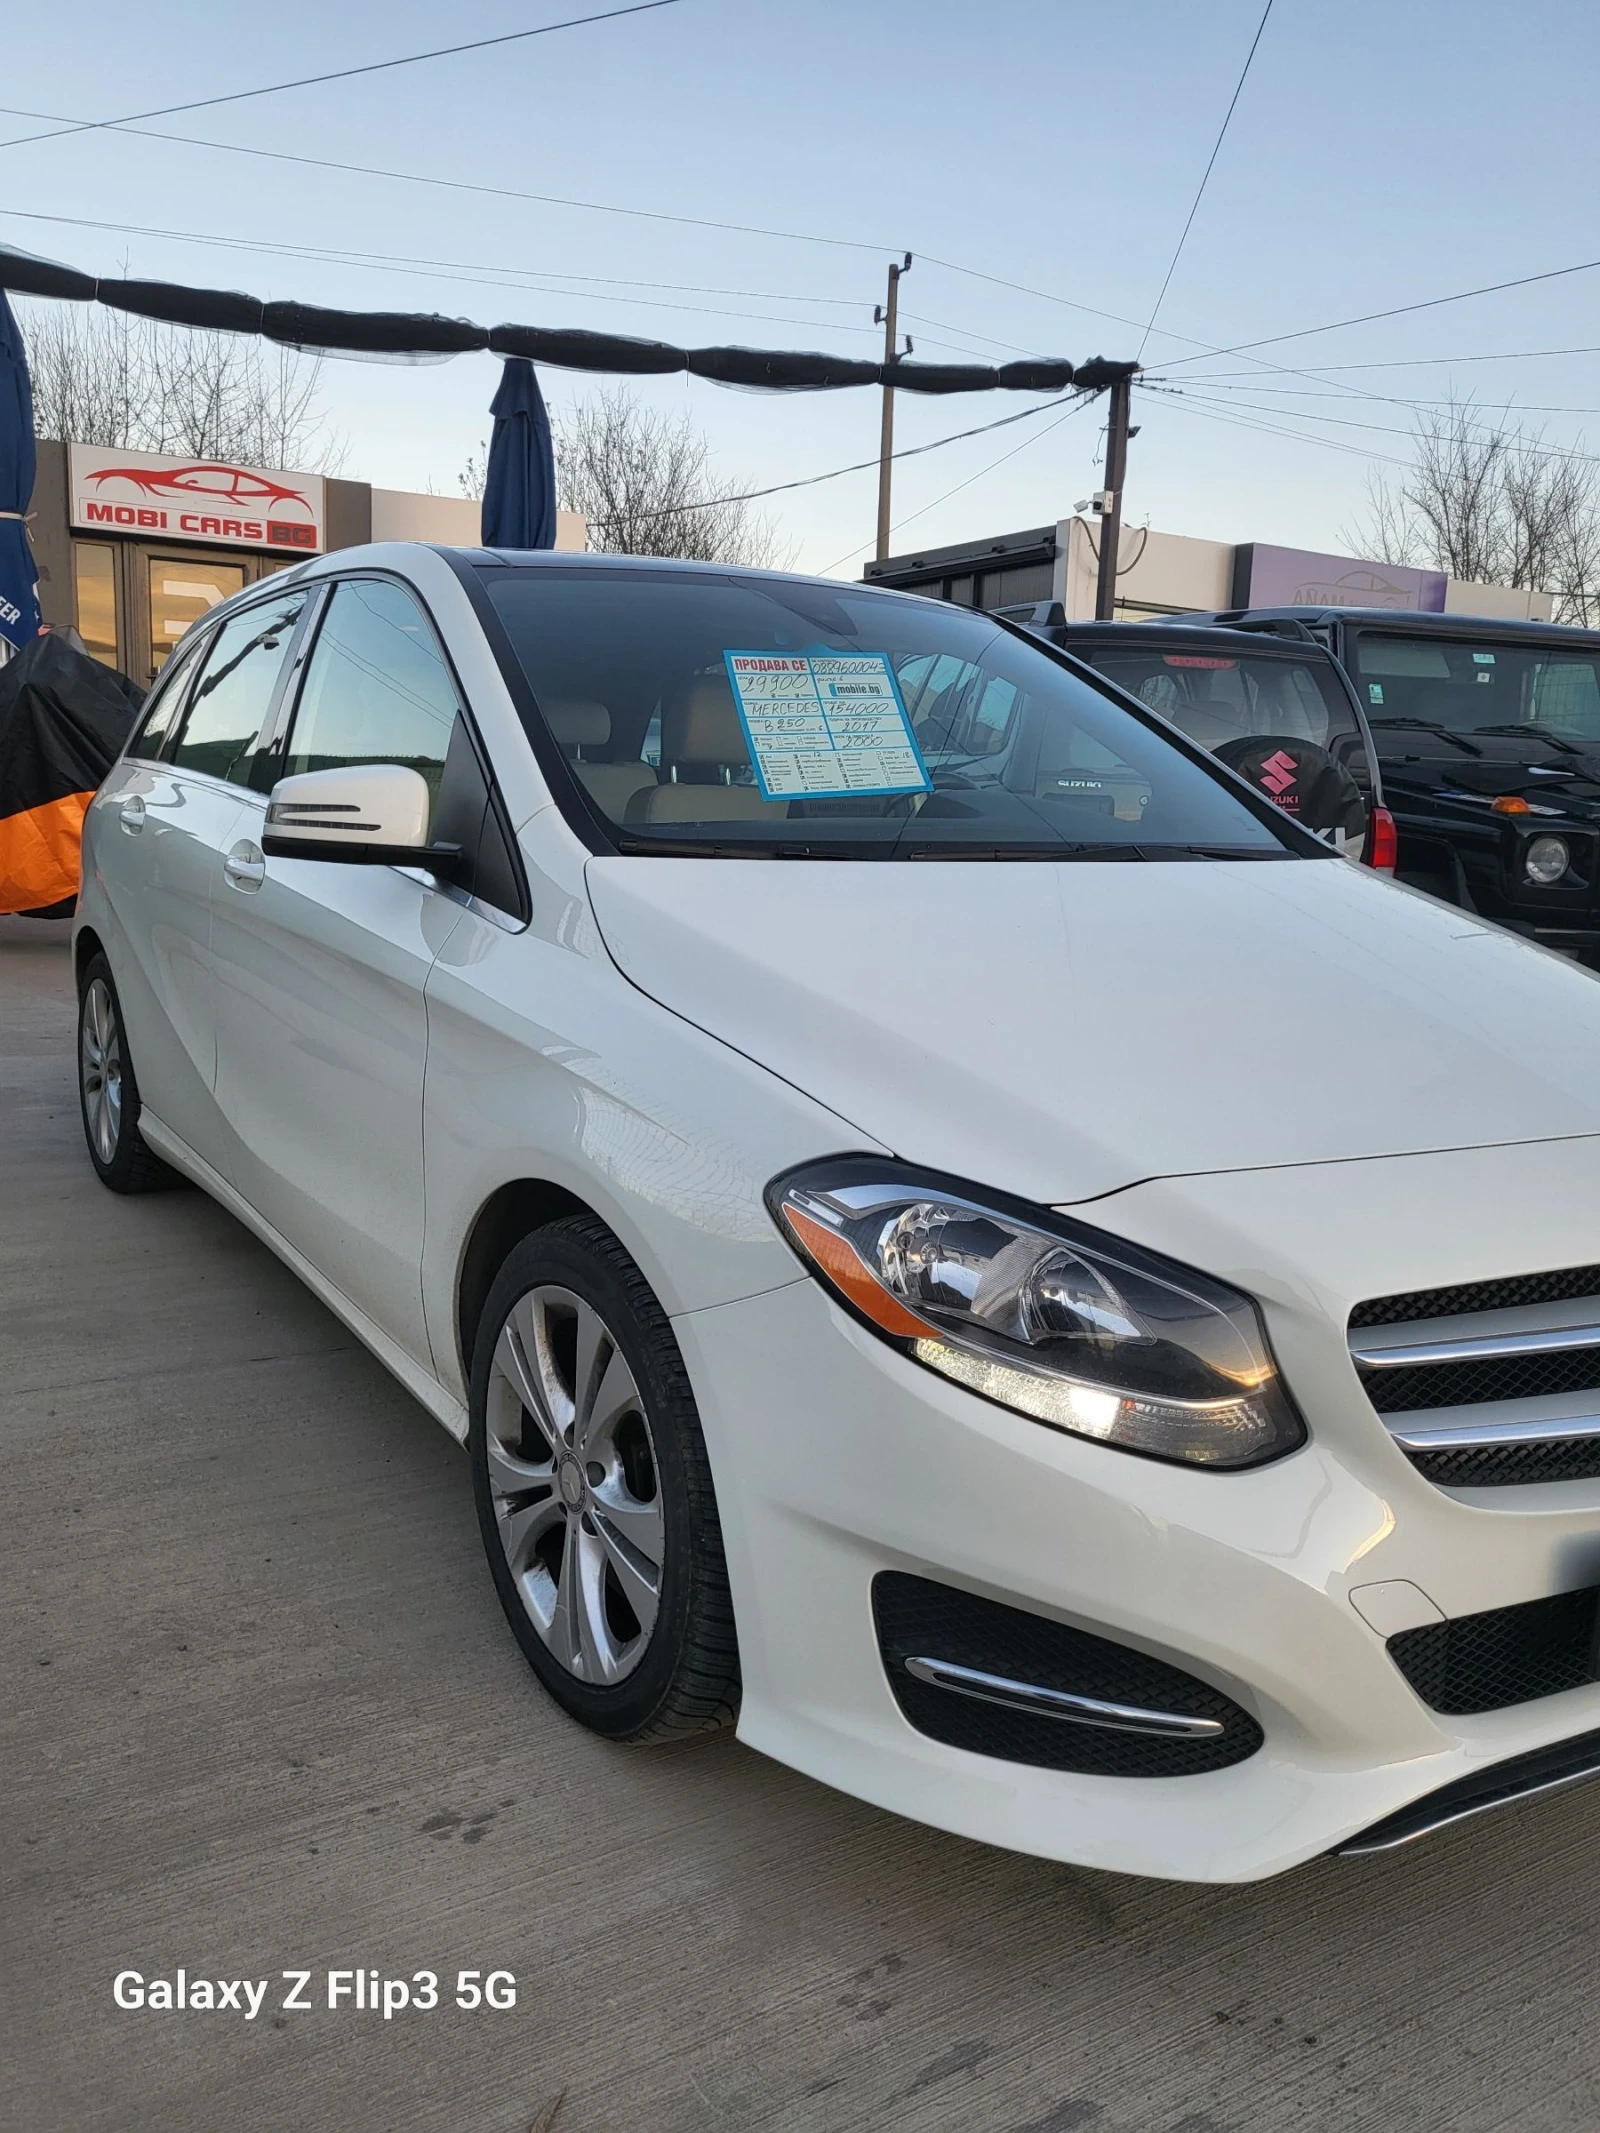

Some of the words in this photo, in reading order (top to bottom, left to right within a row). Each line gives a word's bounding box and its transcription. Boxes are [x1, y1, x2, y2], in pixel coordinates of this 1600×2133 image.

[86, 502, 168, 529] MOBI
[179, 514, 263, 540] CARS
[271, 525, 312, 545] BG
[734, 658, 790, 672] ПРОДАВА
[791, 659, 808, 671] СЕ
[741, 674, 809, 693] 29900
[836, 683, 881, 695] mobile.bg
[751, 701, 820, 717] MERCEDES
[828, 702, 889, 716] 154000
[777, 718, 806, 730] 250
[841, 721, 878, 733] 2017
[842, 736, 883, 749] 2000
